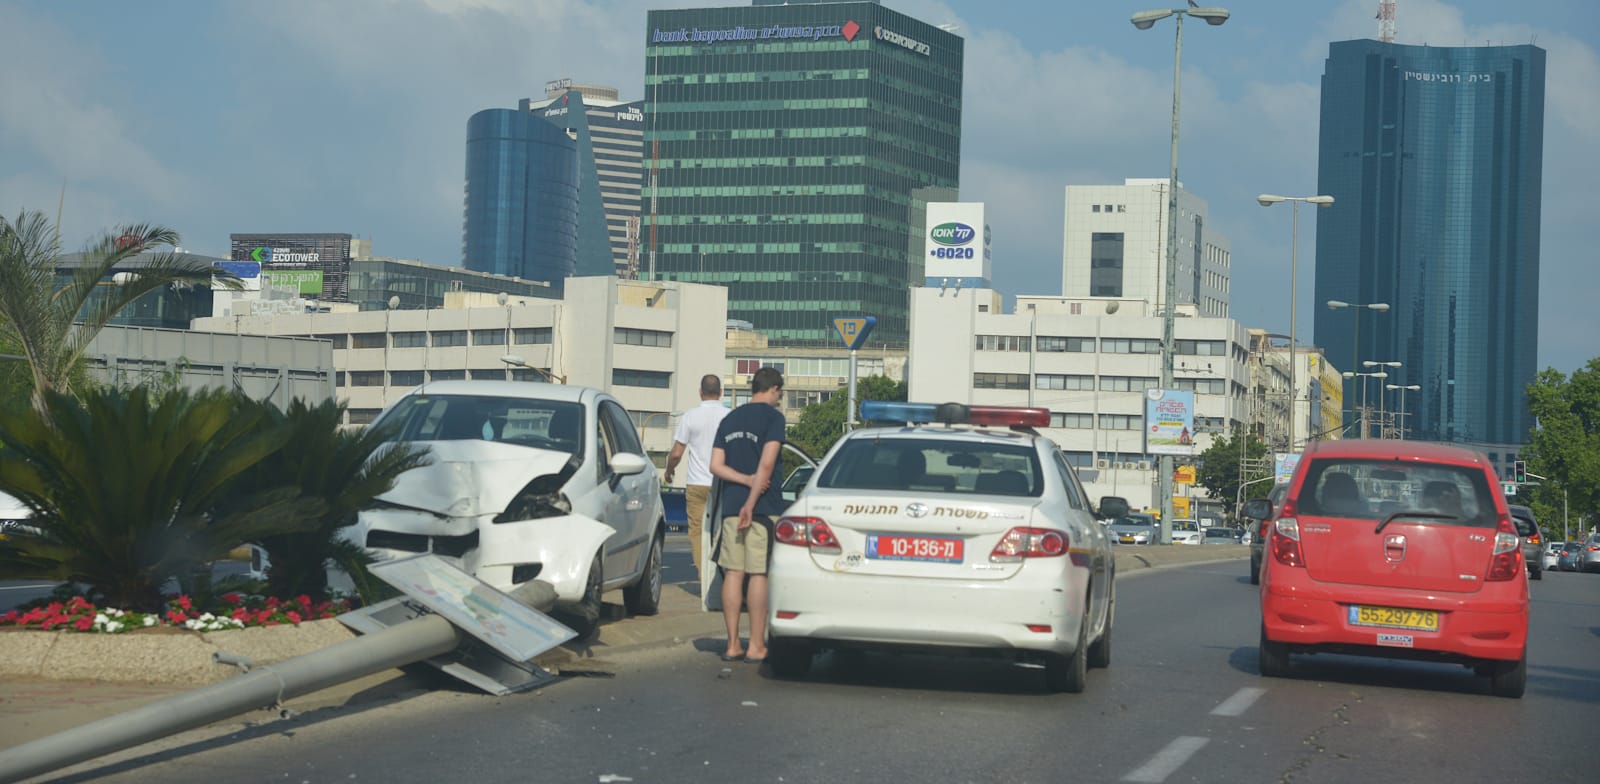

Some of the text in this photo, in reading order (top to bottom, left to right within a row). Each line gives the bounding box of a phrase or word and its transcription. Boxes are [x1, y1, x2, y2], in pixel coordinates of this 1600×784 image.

[652, 26, 758, 44] bank hapoalim
[814, 25, 840, 40] בנק
[1468, 74, 1491, 82] בית
[932, 226, 971, 239] קל אוטו
[272, 253, 320, 262] ECOTOWER
[843, 503, 898, 515] התנועה
[933, 506, 989, 520] משטרת
